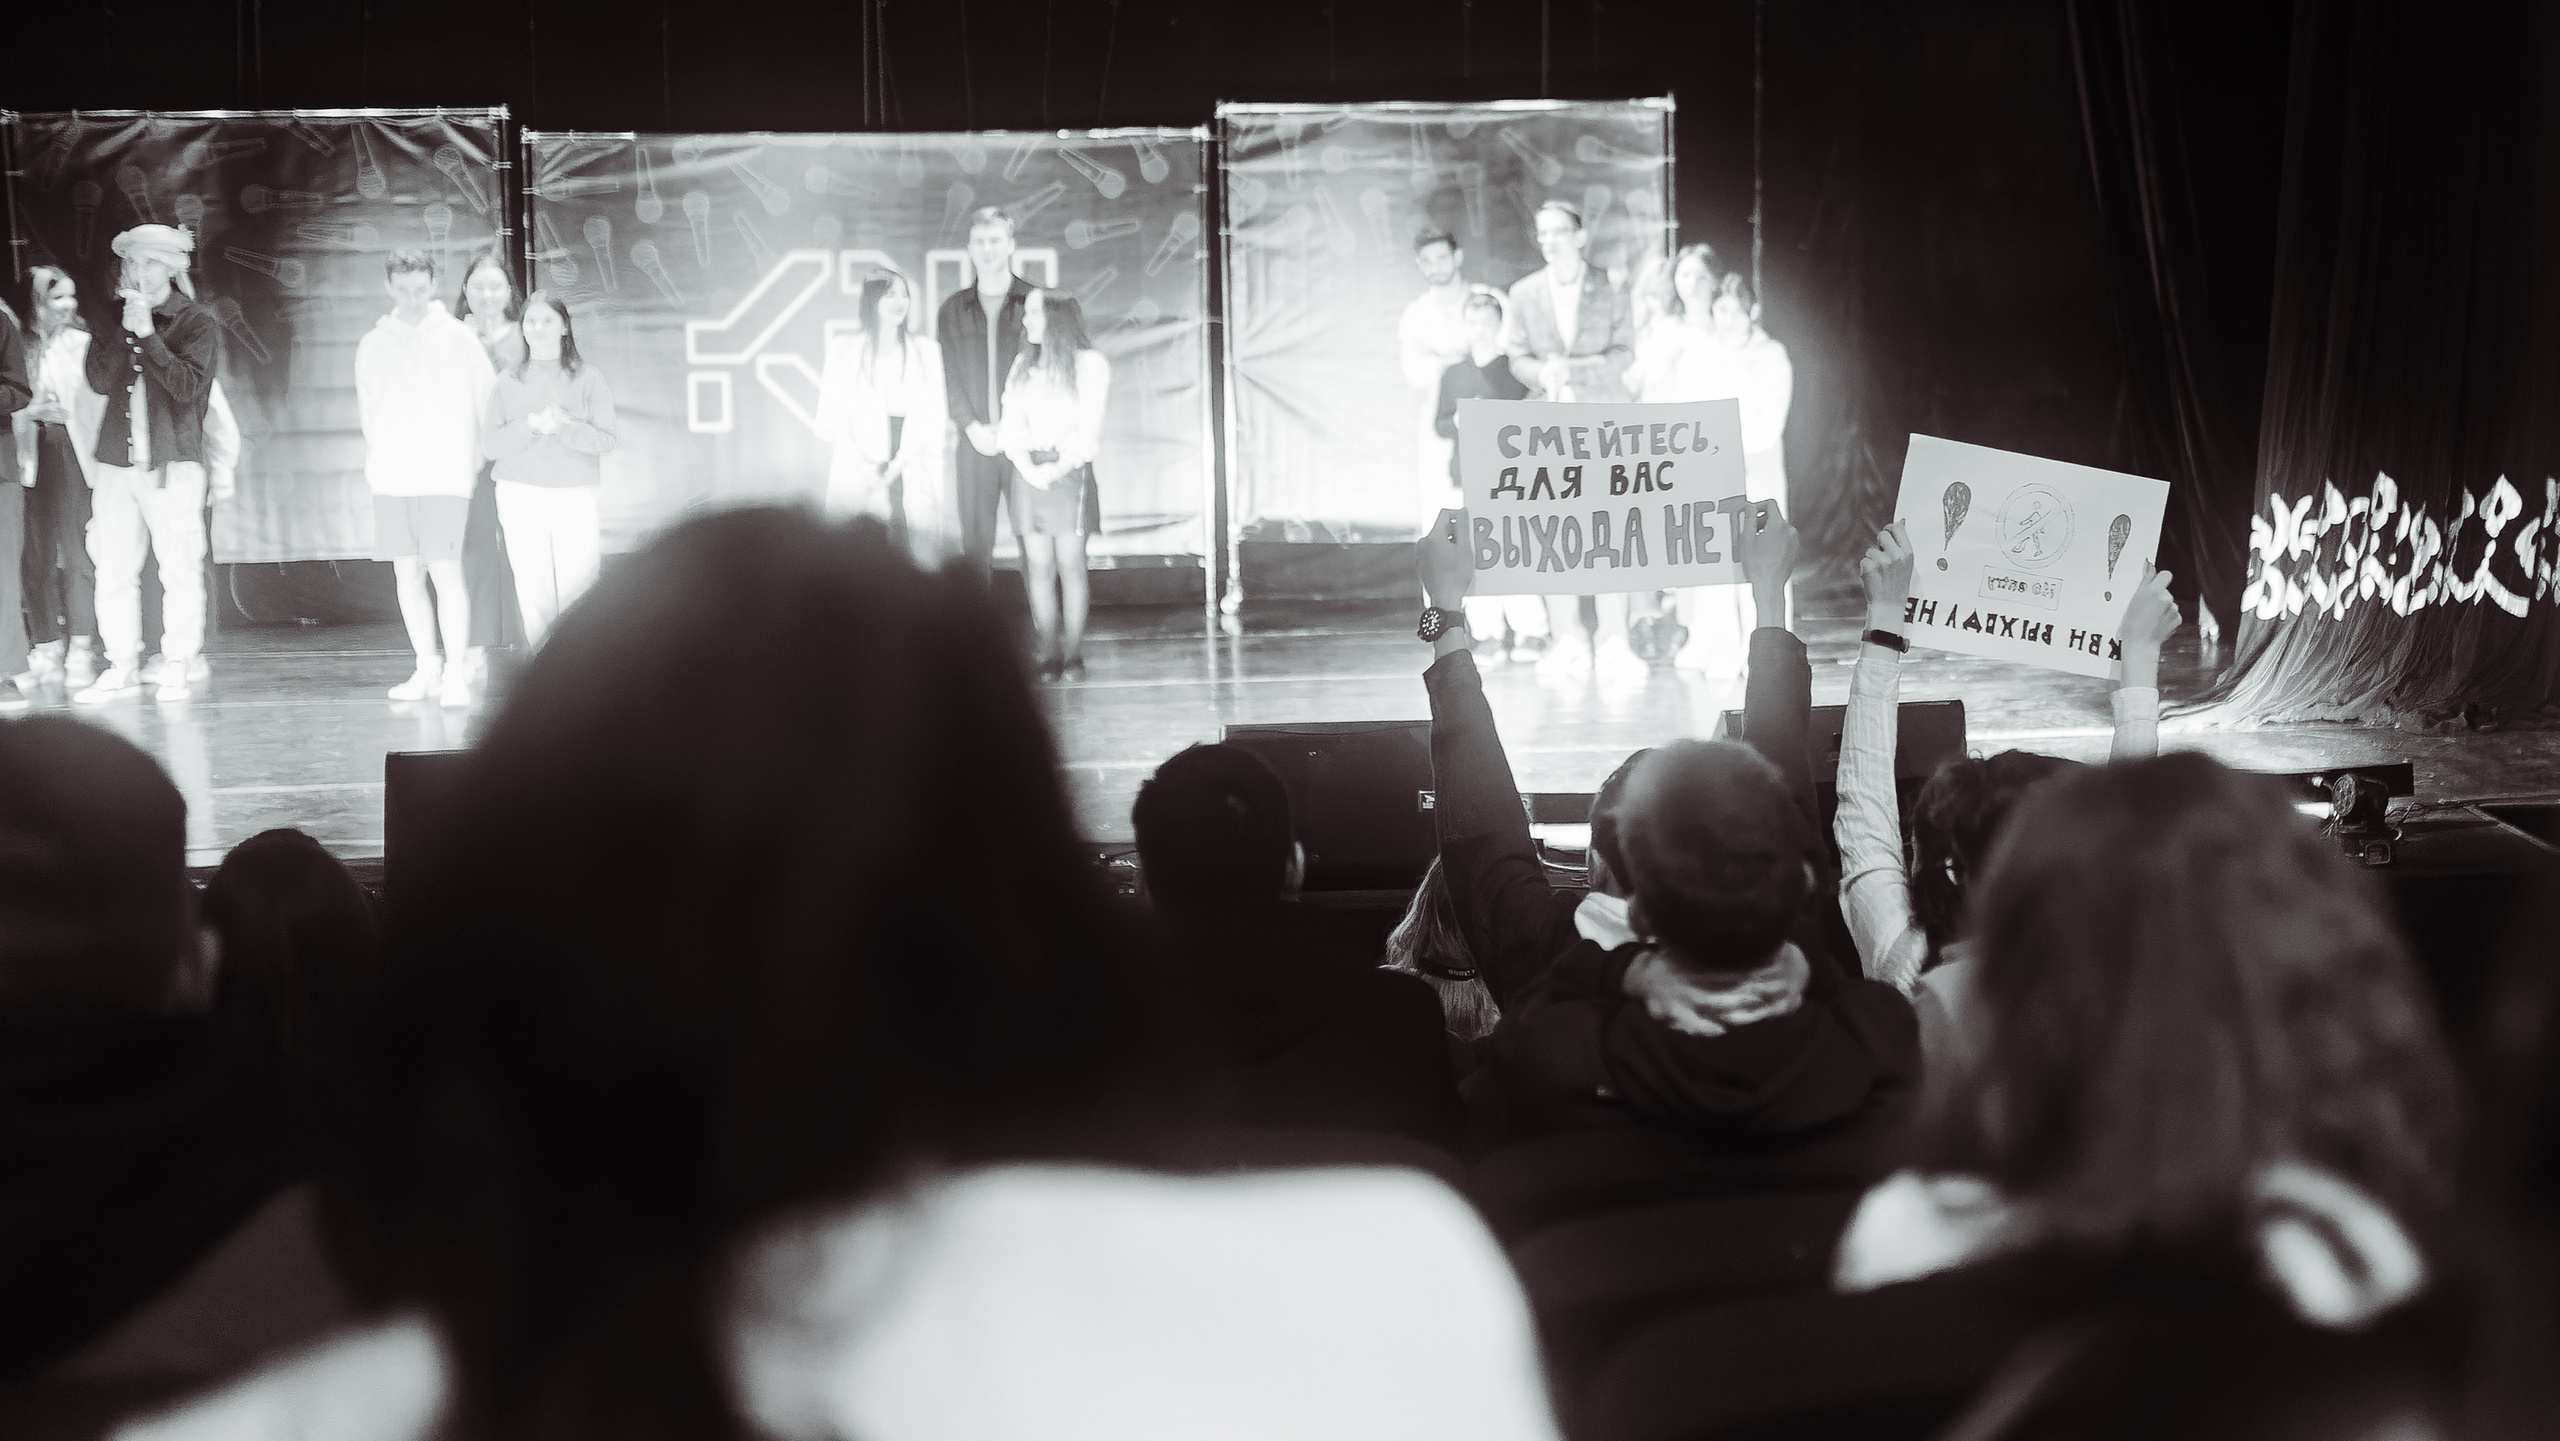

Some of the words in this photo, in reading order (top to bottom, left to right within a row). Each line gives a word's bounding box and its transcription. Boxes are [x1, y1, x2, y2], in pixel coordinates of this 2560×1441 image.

[1497, 421, 1720, 459] СМЕЙТЕСЬ,
[1490, 466, 1583, 501] ДЛЯ
[1610, 461, 1674, 495] ВАС
[1473, 507, 1648, 573] ВЫХОДА
[1663, 495, 1746, 565] НЕТ
